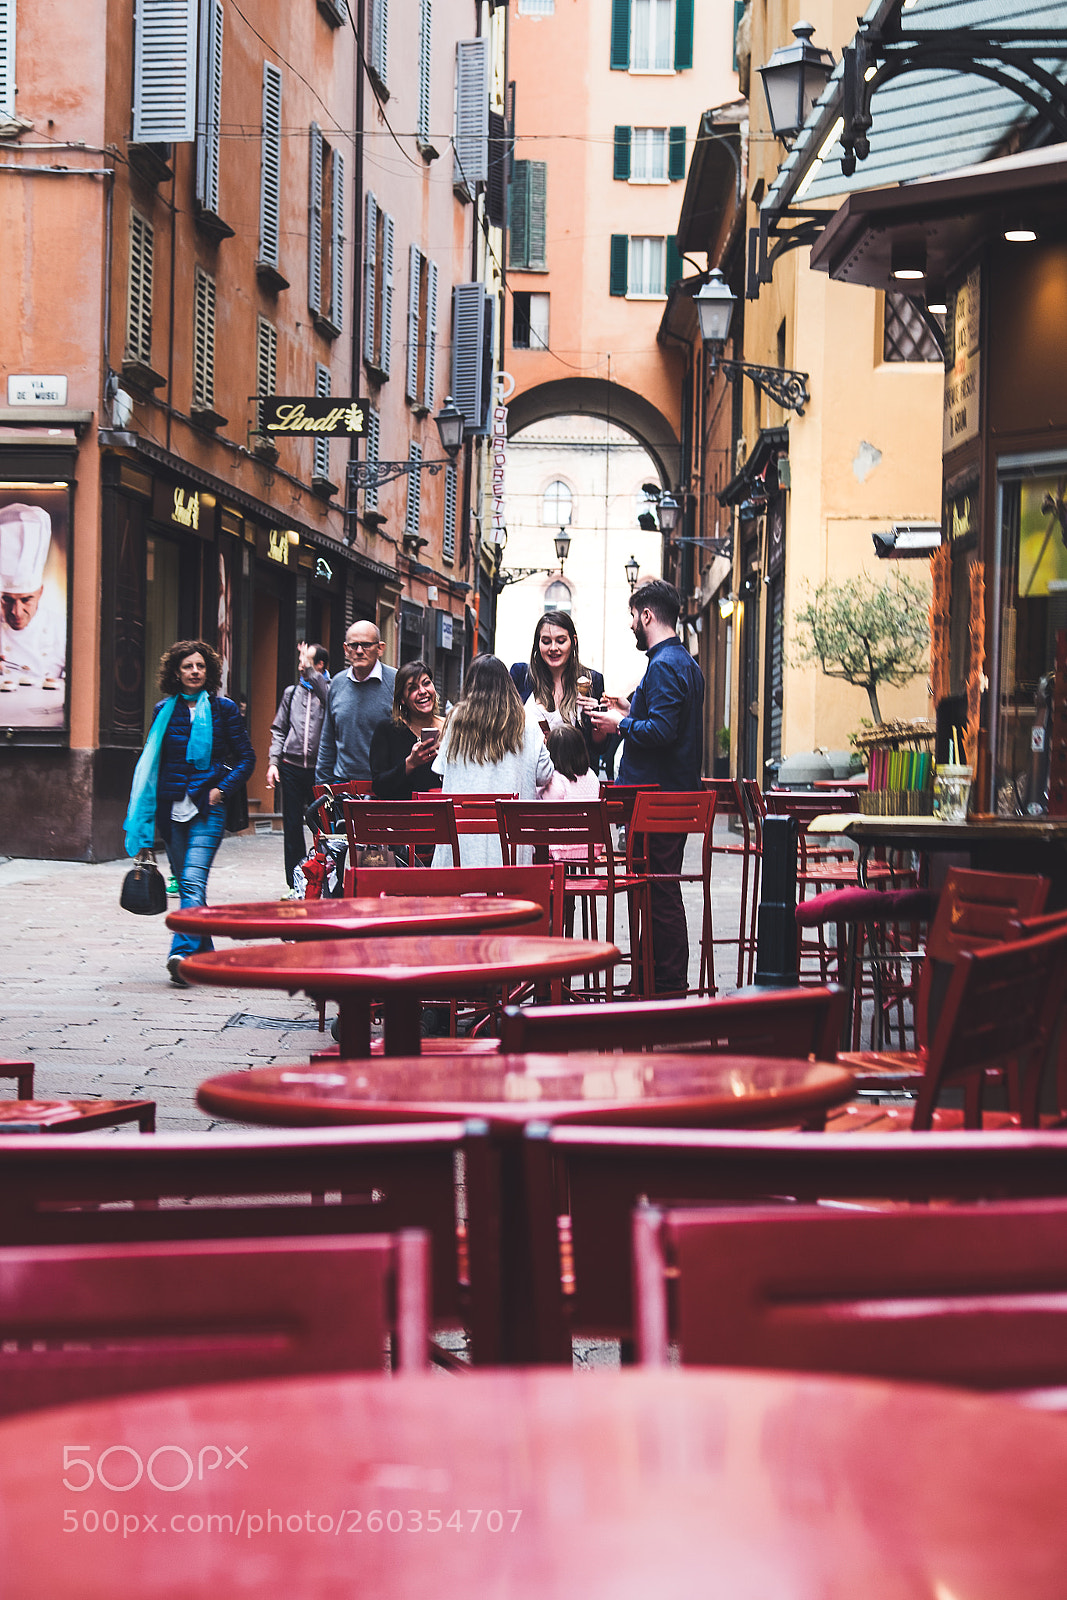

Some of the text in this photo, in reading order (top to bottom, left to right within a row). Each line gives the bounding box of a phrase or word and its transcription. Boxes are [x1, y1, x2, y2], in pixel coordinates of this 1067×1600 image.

[31, 381, 44, 389] VIA
[35, 391, 59, 400] MUSEI
[267, 404, 346, 432] Lindt
[492, 406, 507, 543] QUADRETTI
